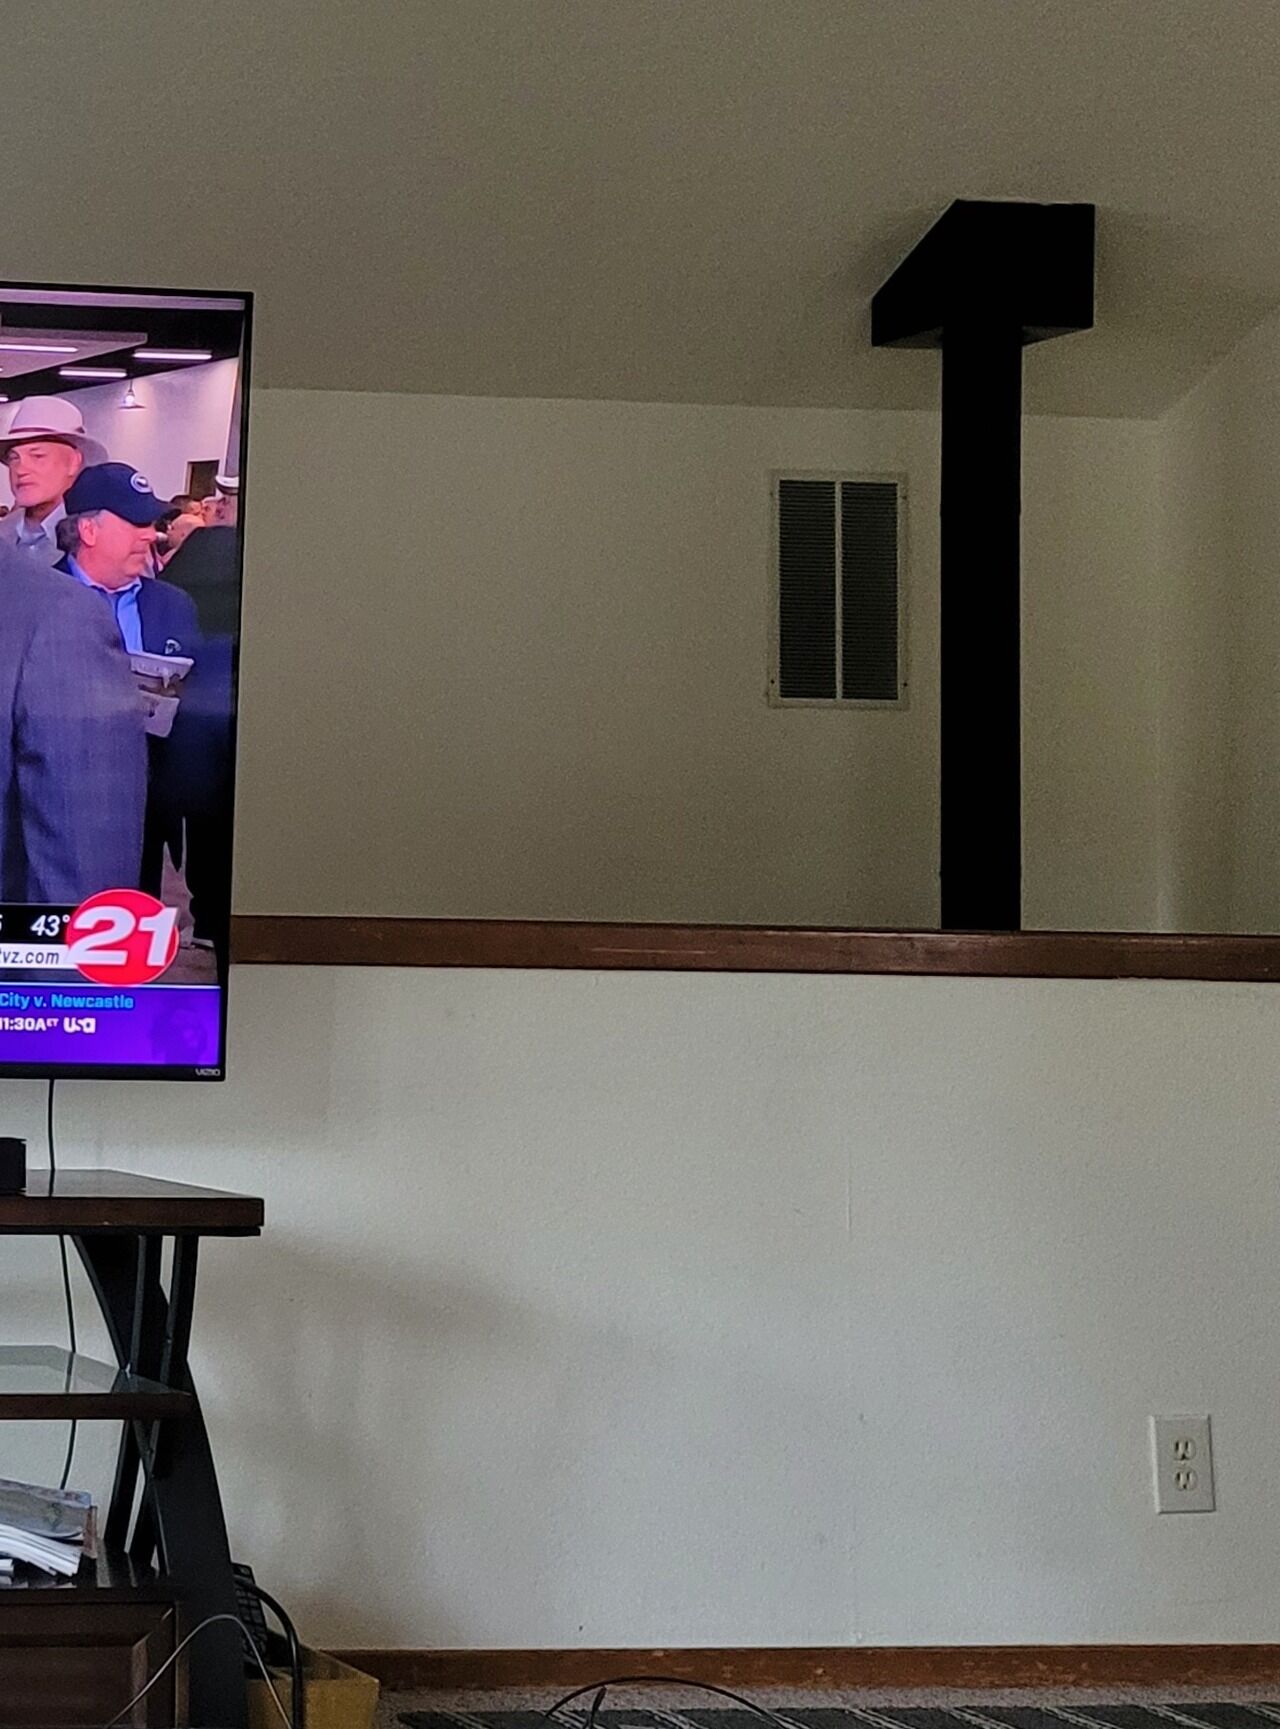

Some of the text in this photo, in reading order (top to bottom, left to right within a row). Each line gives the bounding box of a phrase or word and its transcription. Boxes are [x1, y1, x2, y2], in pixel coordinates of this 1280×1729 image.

[65, 905, 178, 967] 21
[34, 996, 47, 1008] v.
[51, 993, 134, 1009] Newcastle
